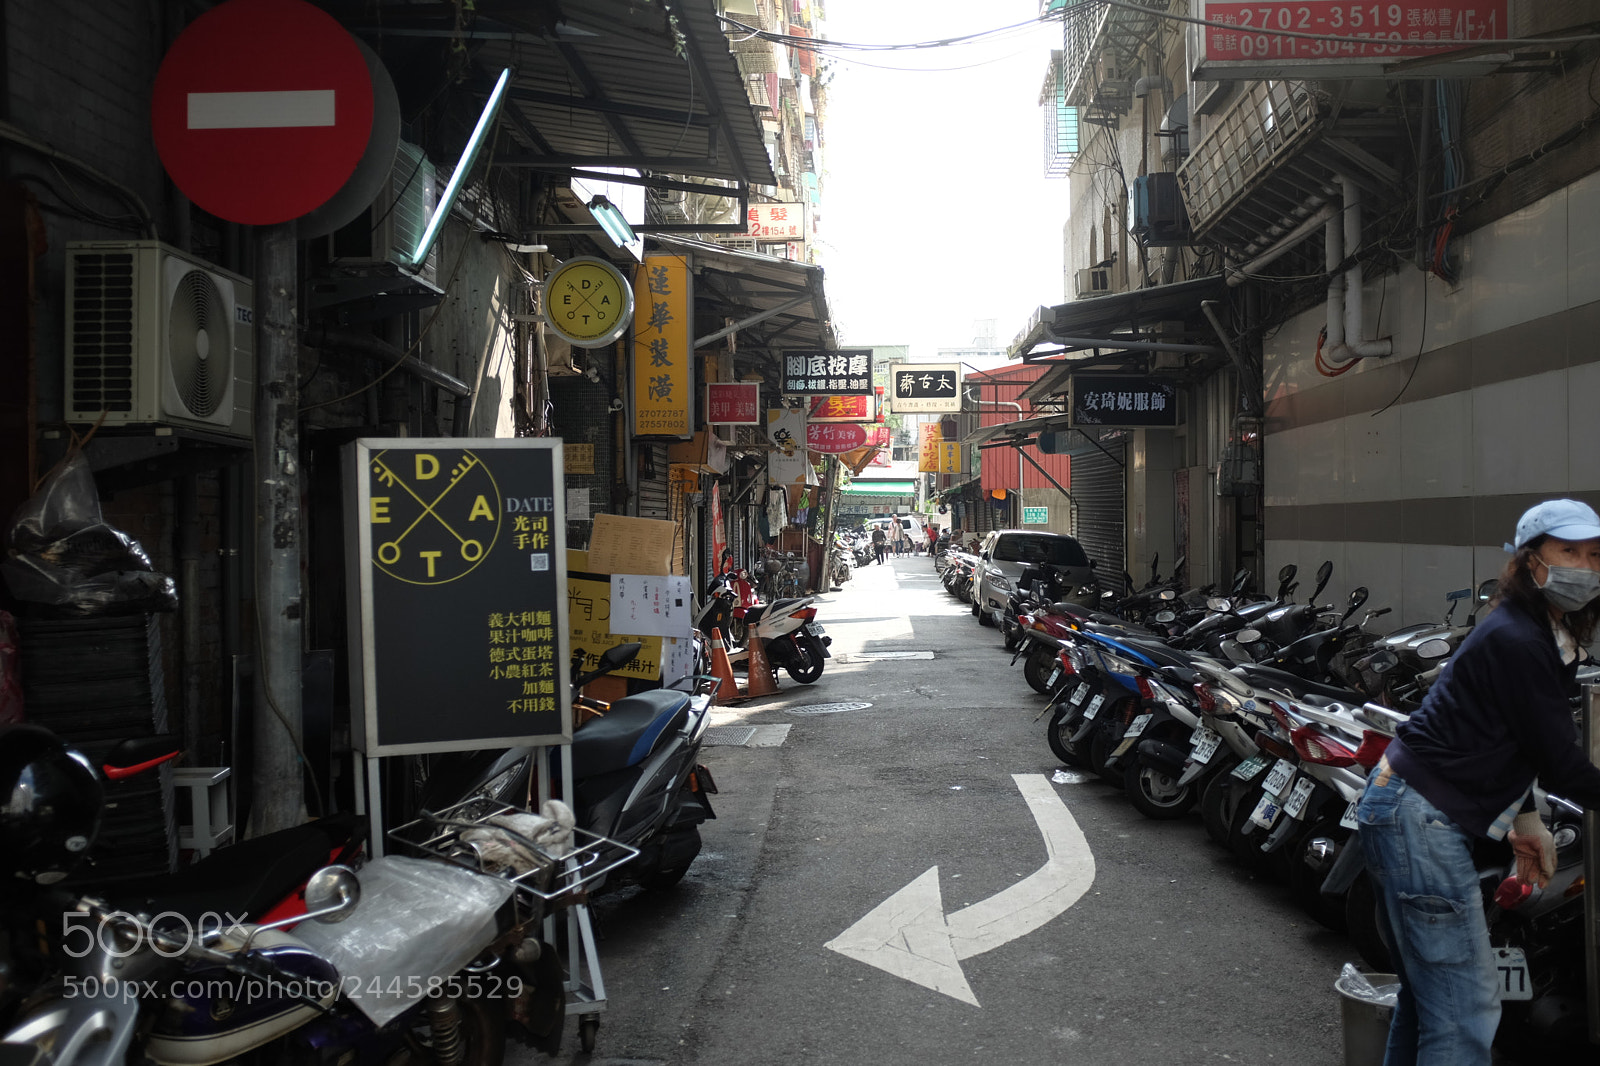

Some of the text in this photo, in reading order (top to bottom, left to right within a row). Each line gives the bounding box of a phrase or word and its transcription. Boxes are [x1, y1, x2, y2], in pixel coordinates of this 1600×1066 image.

[1240, 4, 1402, 29] 2702-3519
[1407, 8, 1452, 26] 張秘書
[1212, 35, 1238, 51] 電話
[1240, 31, 1402, 57] 0911-304759
[582, 280, 591, 290] D
[564, 295, 610, 305] E A
[582, 315, 590, 325] T
[647, 265, 674, 403] 蓮華裝潢
[787, 355, 868, 377] 腳底按摩
[639, 409, 685, 418] 27072787
[639, 420, 685, 429] 27557802
[415, 454, 440, 480] D
[370, 495, 494, 523] E A
[506, 497, 553, 513] DATE
[513, 515, 549, 532] 光司
[513, 533, 549, 550] 手作
[420, 551, 442, 577] T
[488, 610, 552, 628] 義大利麵
[489, 627, 554, 645] 果汁咖啡
[489, 645, 553, 664] 德式蛋塔
[489, 662, 554, 680] 小農紅茶
[522, 680, 555, 696] 加麵
[507, 698, 556, 714] 不用錢
[1498, 966, 1525, 992] 77
